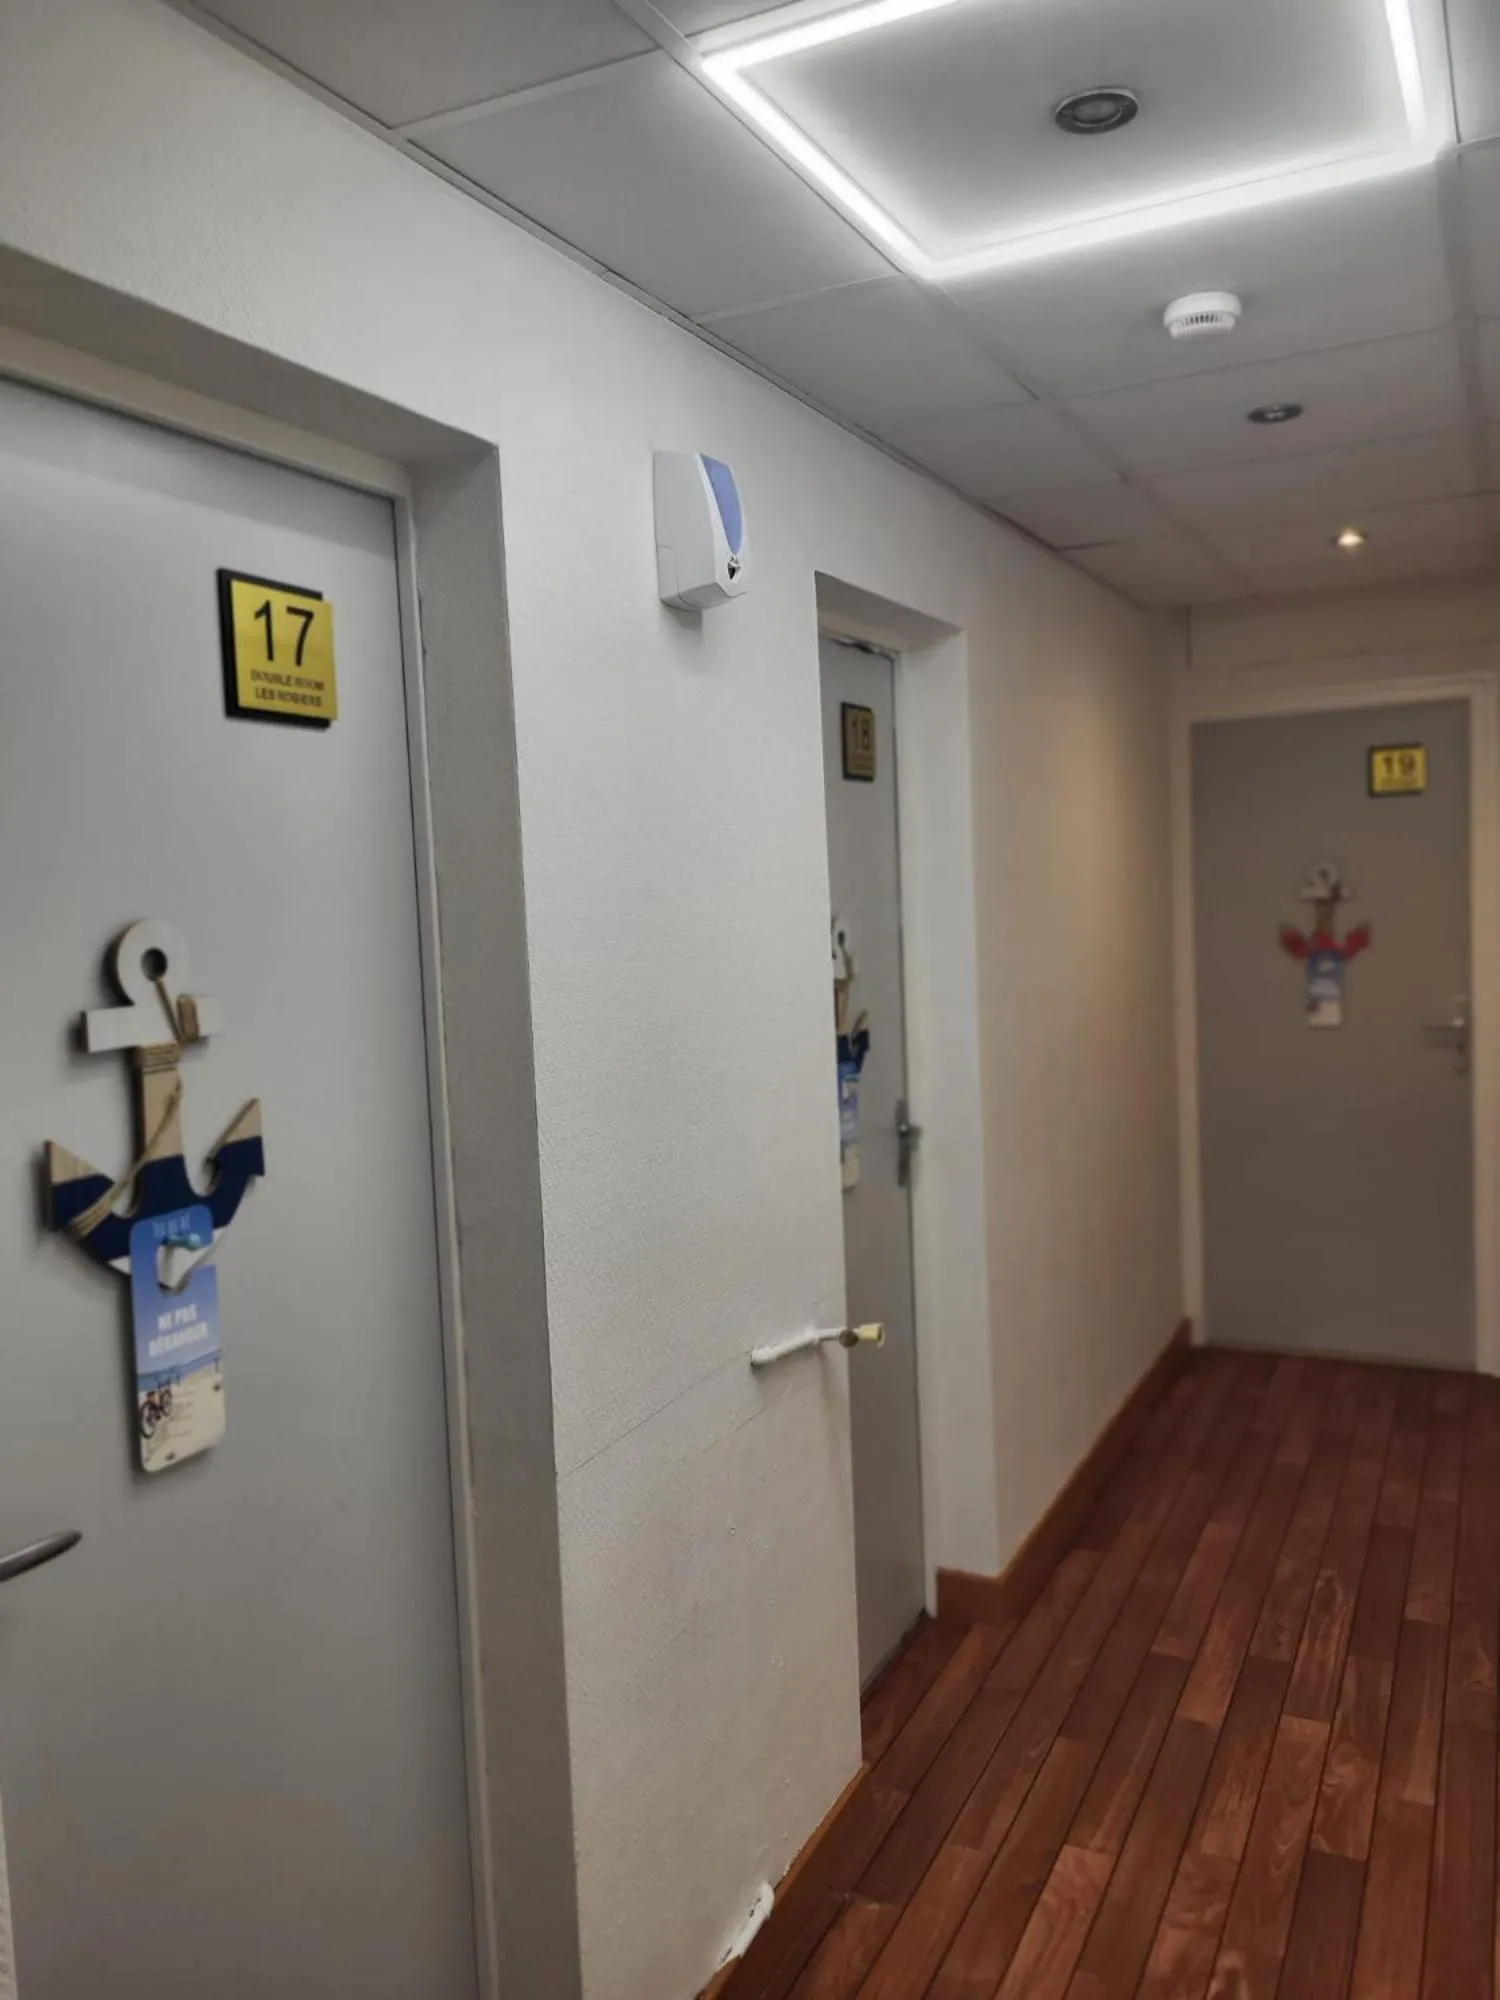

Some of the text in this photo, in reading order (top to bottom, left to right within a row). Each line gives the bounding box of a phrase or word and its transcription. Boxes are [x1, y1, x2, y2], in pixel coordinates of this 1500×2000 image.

[254, 599, 315, 668] 17
[852, 716, 871, 752] 18
[1382, 754, 1416, 777] 19
